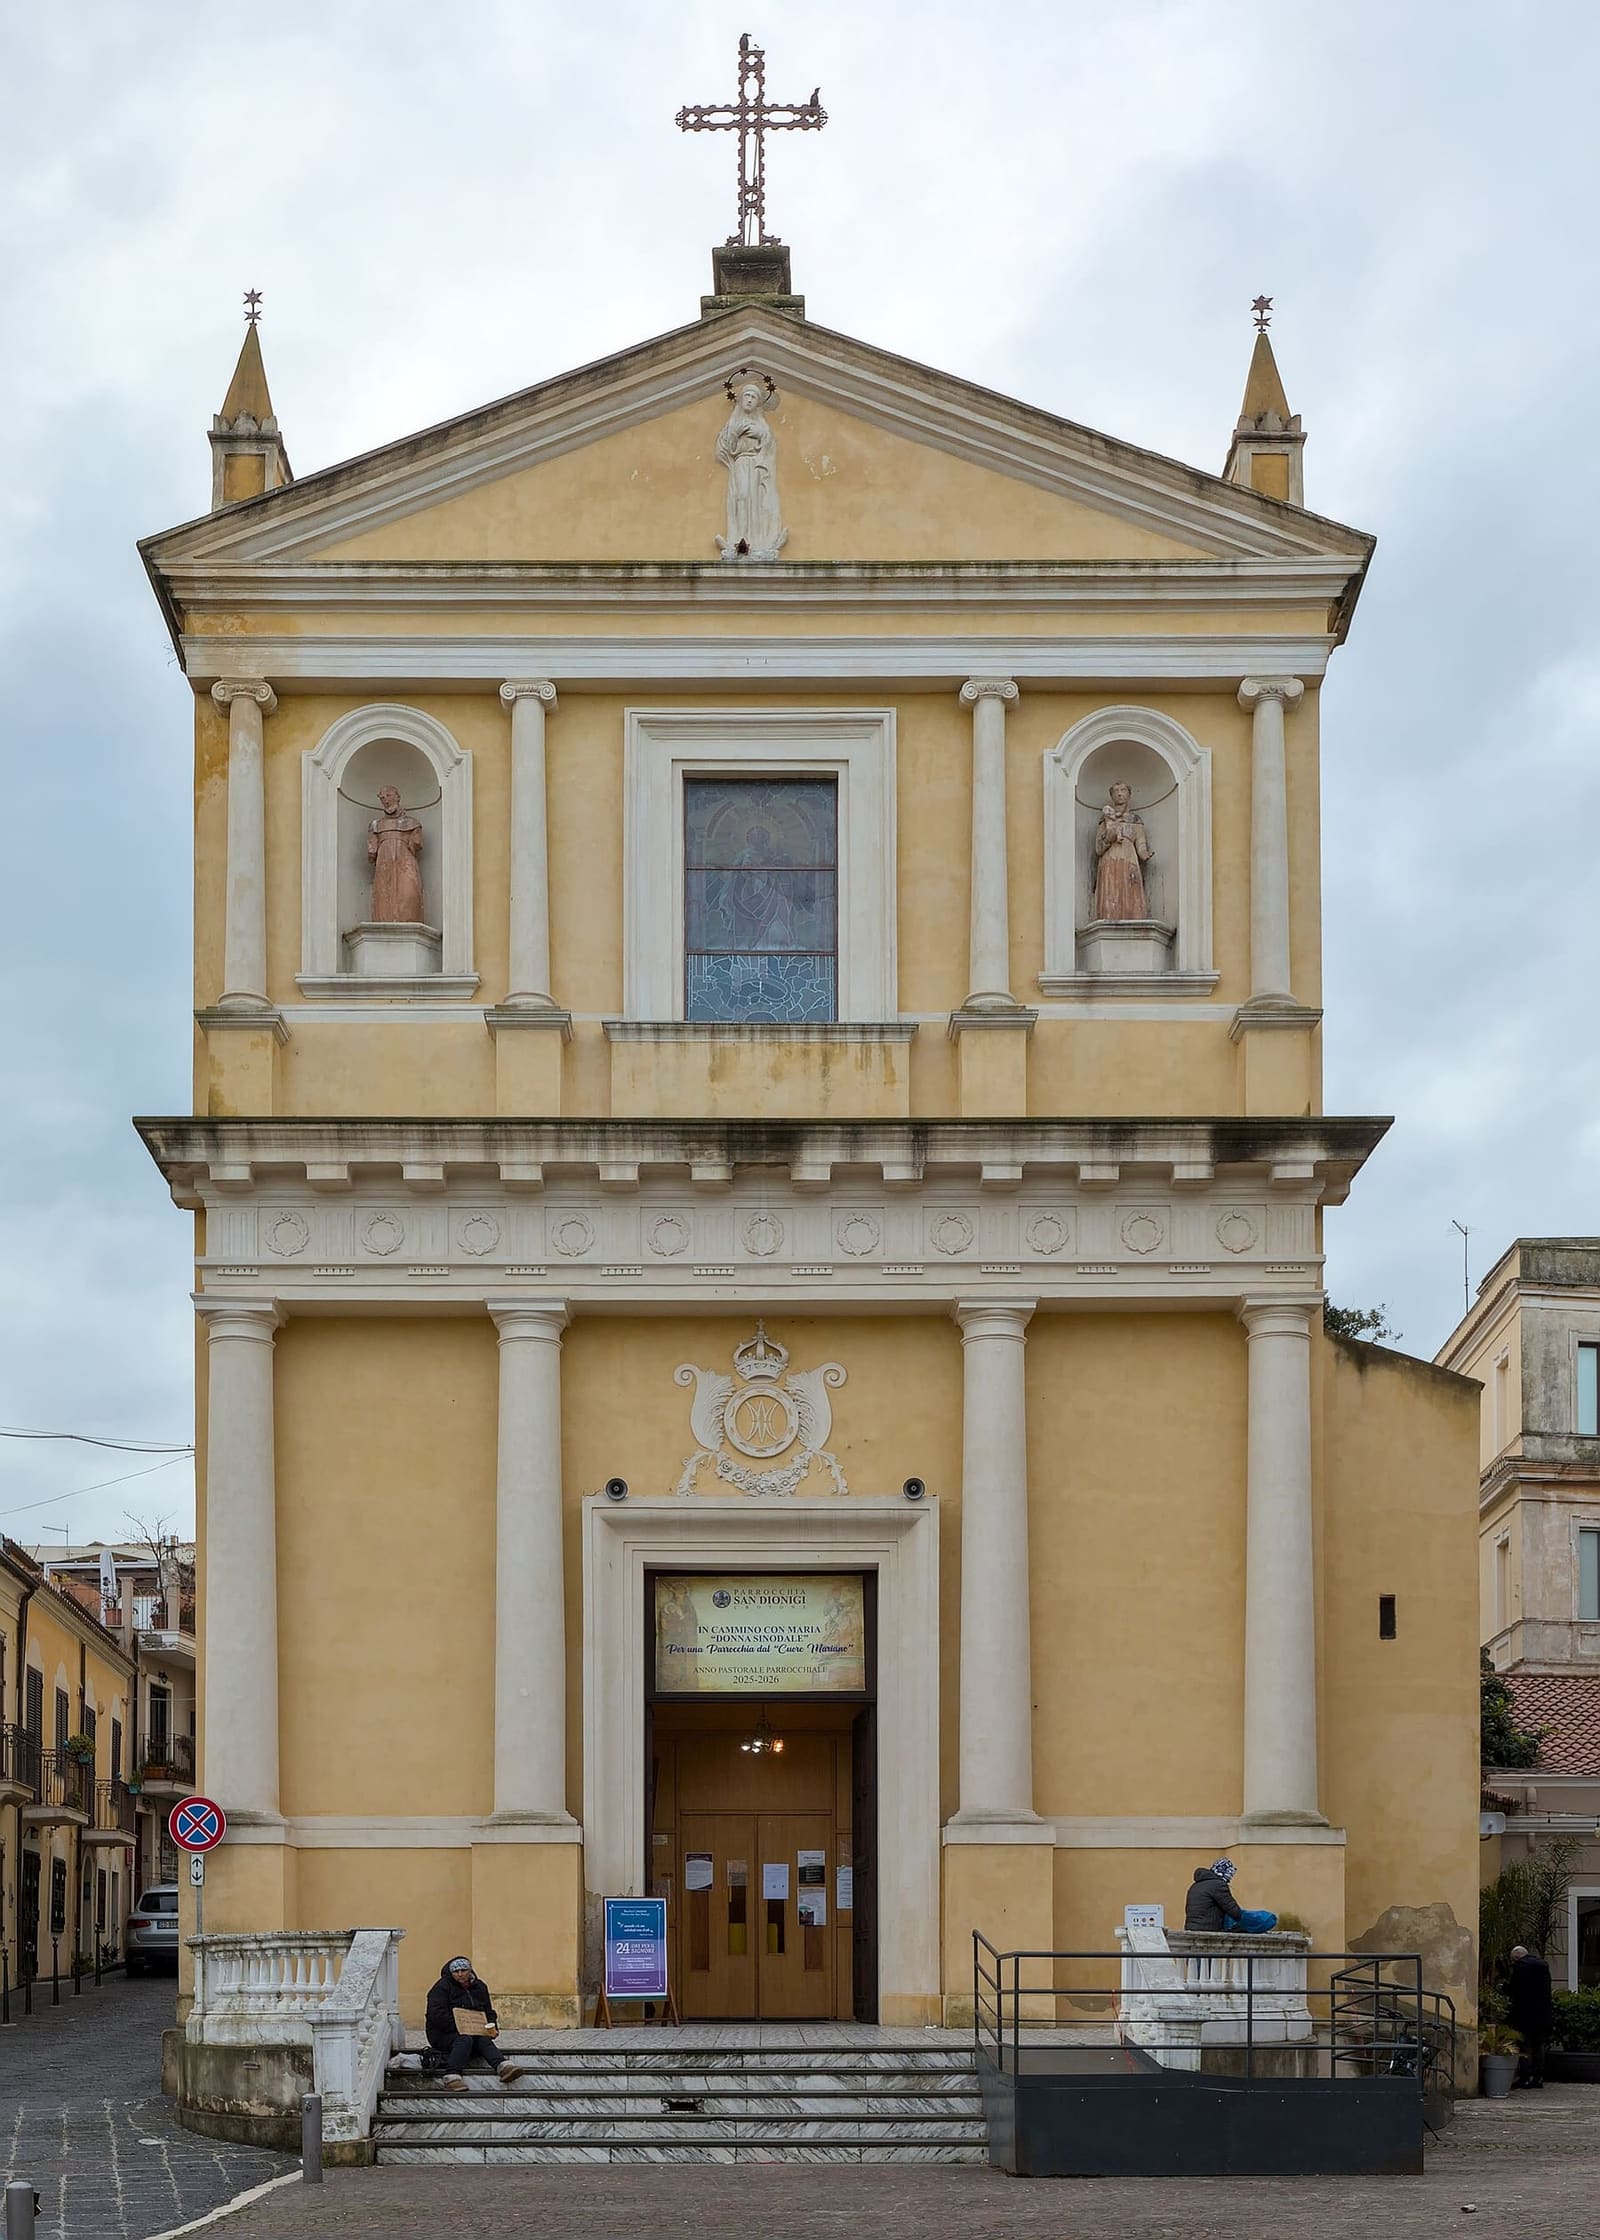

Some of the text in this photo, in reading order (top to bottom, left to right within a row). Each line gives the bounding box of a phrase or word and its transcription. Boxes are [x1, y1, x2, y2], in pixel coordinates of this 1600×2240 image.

[734, 1596, 806, 1605] SAN DIONIGI
[698, 1626, 709, 1634] IN
[711, 1626, 762, 1634] CAMMINO
[763, 1626, 785, 1634] CON
[665, 1643, 685, 1654] Per
[706, 1643, 755, 1654] Parrocchia
[756, 1645, 771, 1653] dal
[733, 1675, 780, 1684] 2025-2026
[616, 1942, 630, 1954] 24
